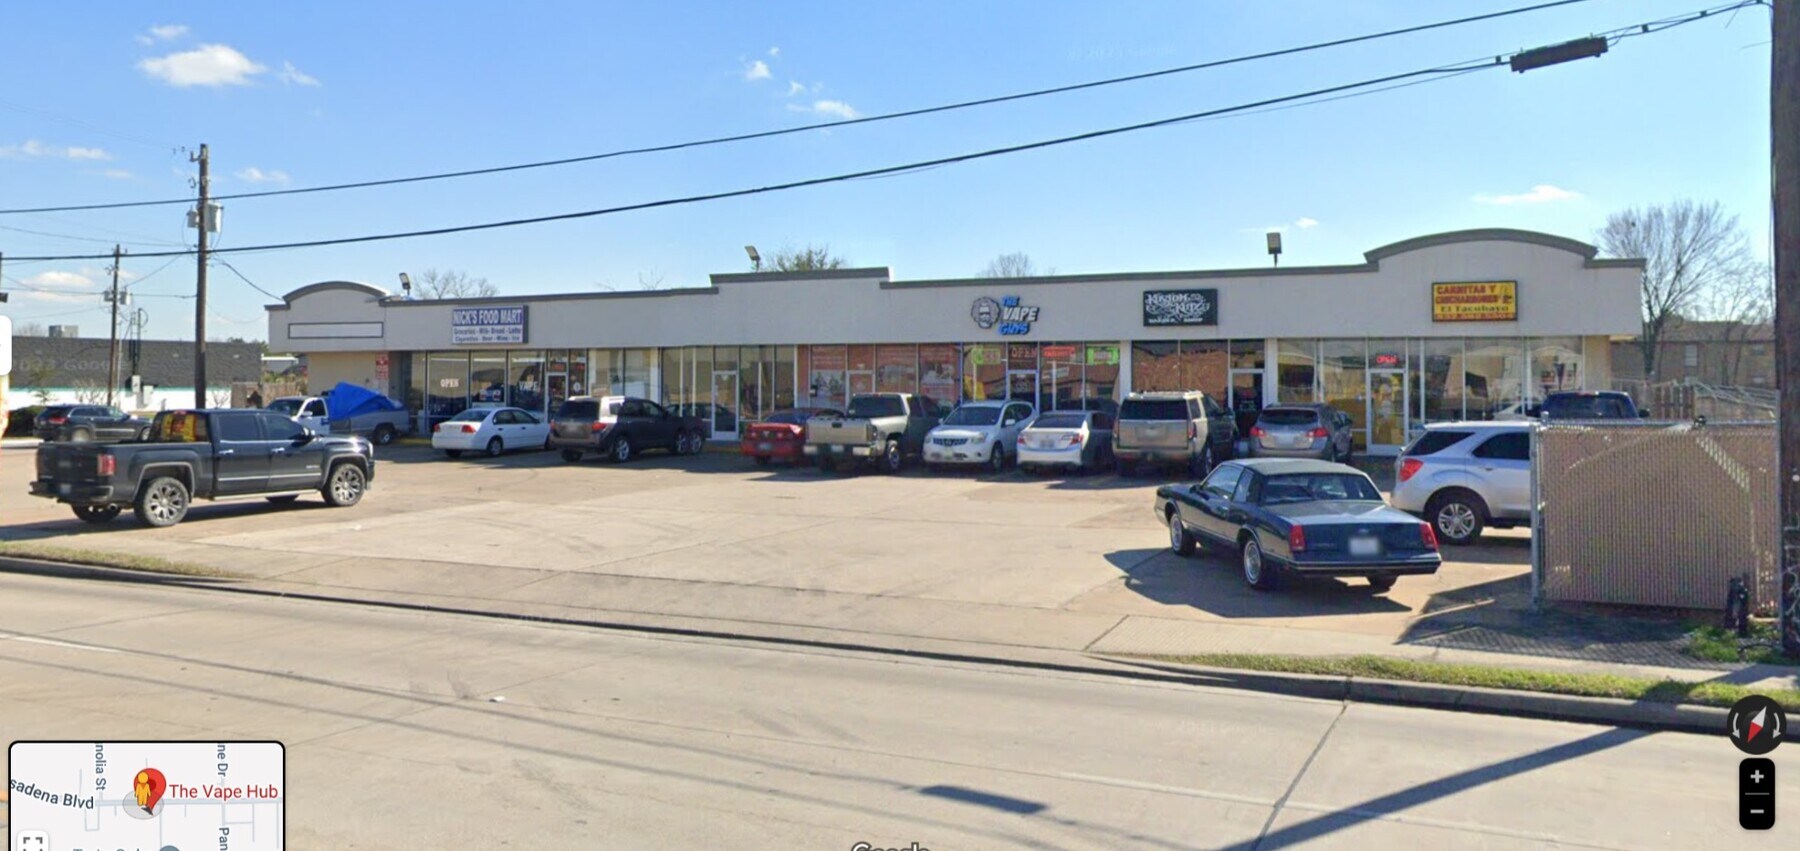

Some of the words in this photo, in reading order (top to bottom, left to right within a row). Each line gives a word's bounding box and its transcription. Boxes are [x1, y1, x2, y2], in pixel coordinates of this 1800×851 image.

[1437, 285, 1486, 294] CARNITAS
[1489, 285, 1496, 293] Y
[1002, 296, 1019, 307] THE
[453, 309, 478, 325] NICK'S
[479, 309, 499, 324] FOOD
[500, 308, 522, 324] MART
[1003, 307, 1039, 321] VAPE
[999, 321, 1030, 335] GUYS
[1011, 347, 1038, 358] OPEN
[440, 378, 460, 388] OPEN
[519, 380, 539, 391] VAPE
